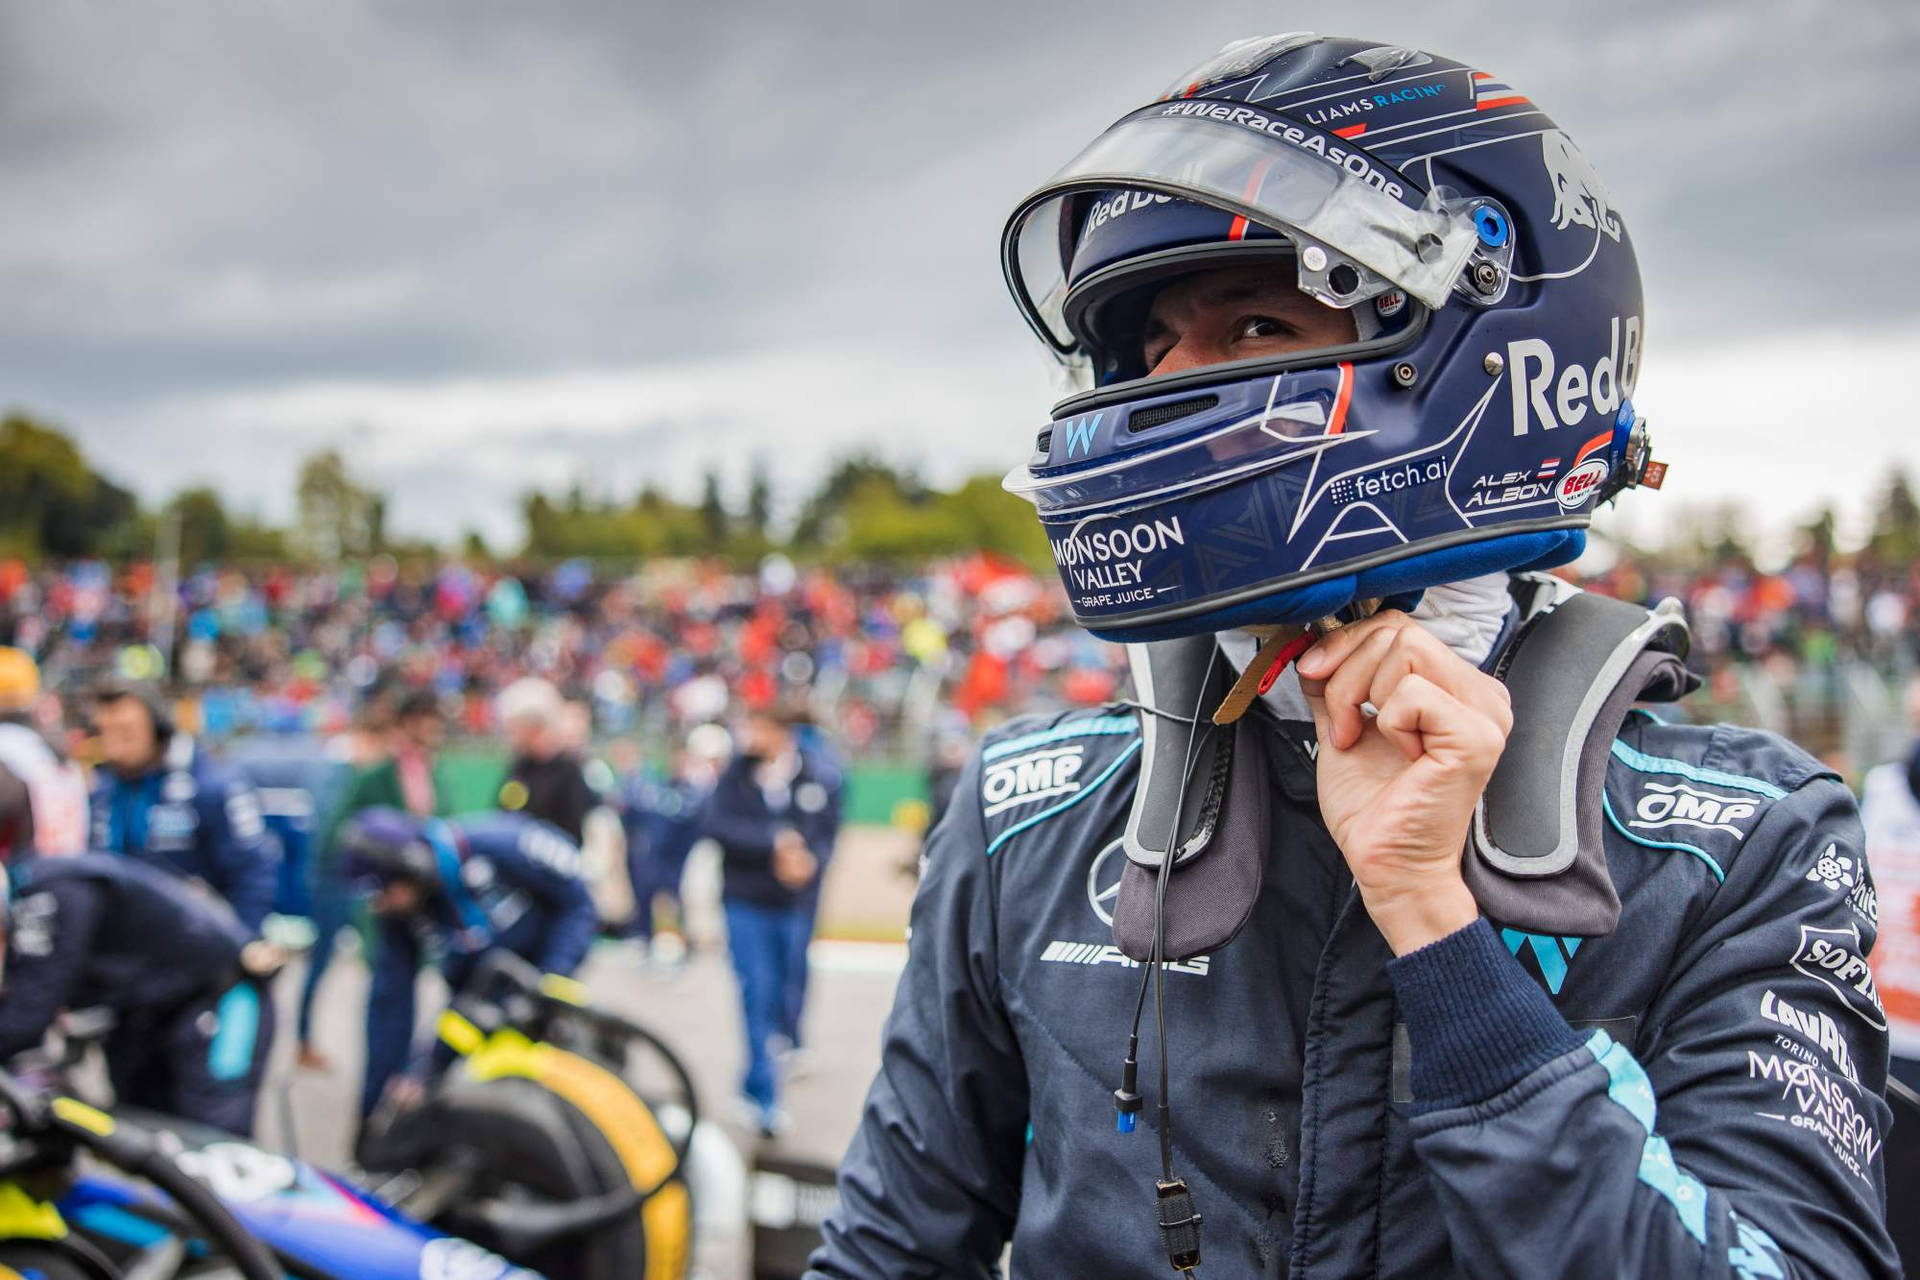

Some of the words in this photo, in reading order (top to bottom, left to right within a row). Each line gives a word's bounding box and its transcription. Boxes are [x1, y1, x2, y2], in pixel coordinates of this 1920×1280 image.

[1161, 101, 1404, 201] #WeRaceAsOne
[1355, 456, 1448, 498] fetch.ai
[1465, 481, 1553, 508] ALBON
[1472, 470, 1532, 488] ALEX
[1563, 470, 1602, 496] BELL
[1050, 516, 1184, 567] MONSOON
[1073, 560, 1143, 591] VALLEY
[1081, 592, 1112, 608] GRAPE
[1115, 587, 1154, 605] JUICE
[984, 754, 1084, 804] OMP
[1636, 792, 1756, 824] OMP
[1774, 1034, 1819, 1067] TORINO
[1748, 1050, 1881, 1166] MONSOON
[1796, 1087, 1858, 1156] VALLEY
[1790, 1115, 1835, 1146] GRAPE
[1834, 1144, 1860, 1177] JUICE
